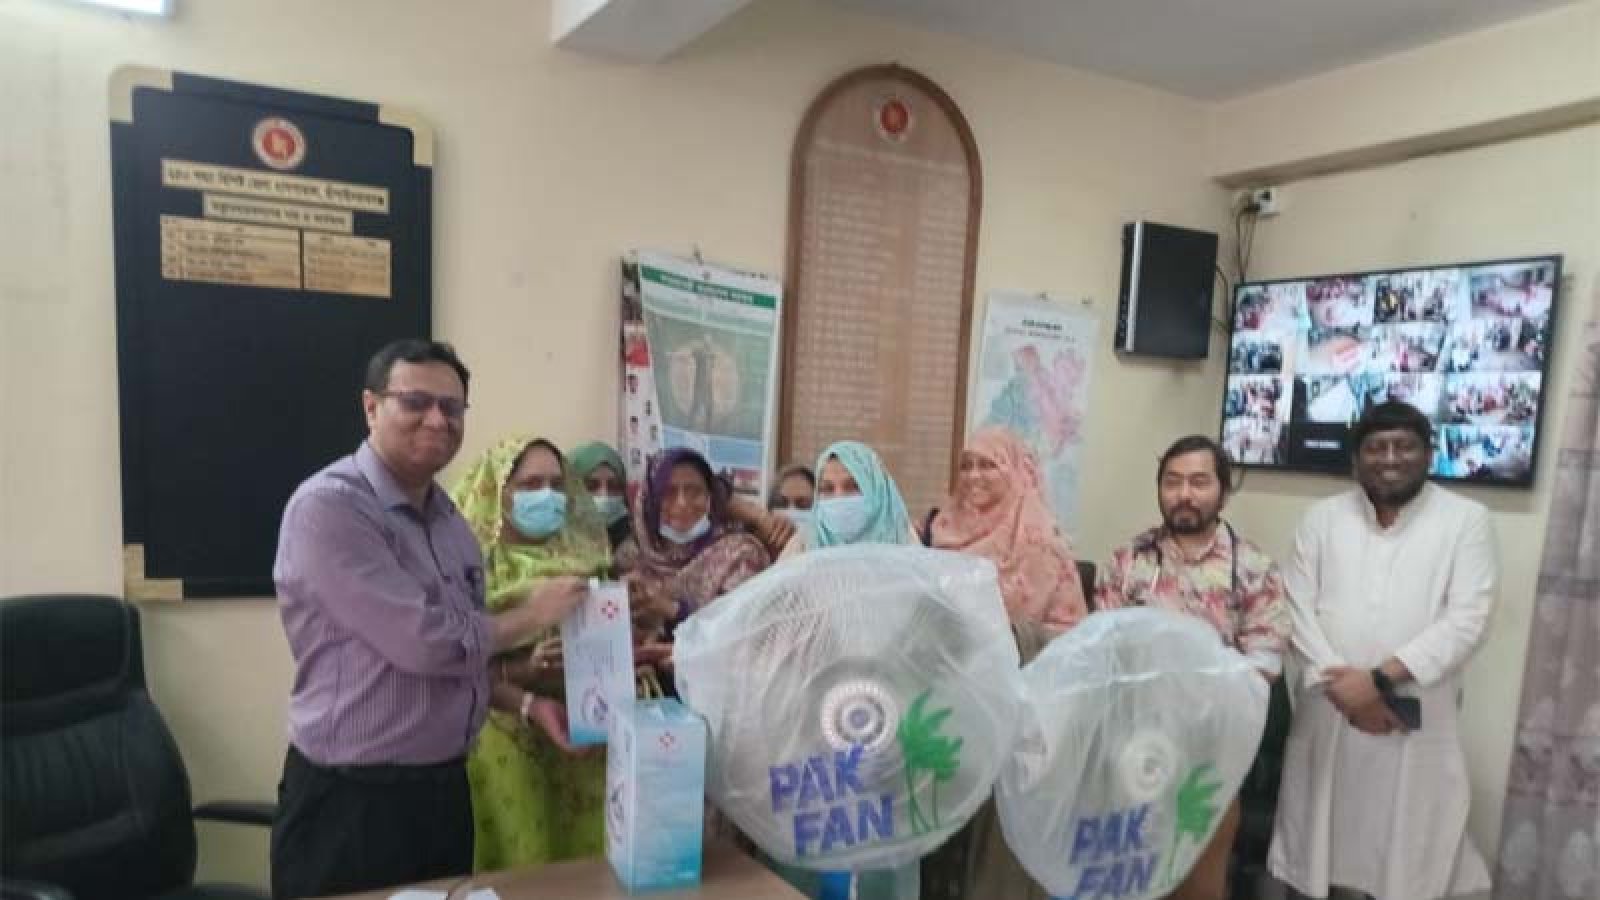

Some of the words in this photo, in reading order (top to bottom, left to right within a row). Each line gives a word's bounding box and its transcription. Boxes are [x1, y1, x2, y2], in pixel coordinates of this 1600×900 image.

[769, 743, 864, 814] PAK
[793, 795, 894, 857] FAN
[1069, 804, 1149, 865] PAK
[1073, 854, 1158, 899] FAN
